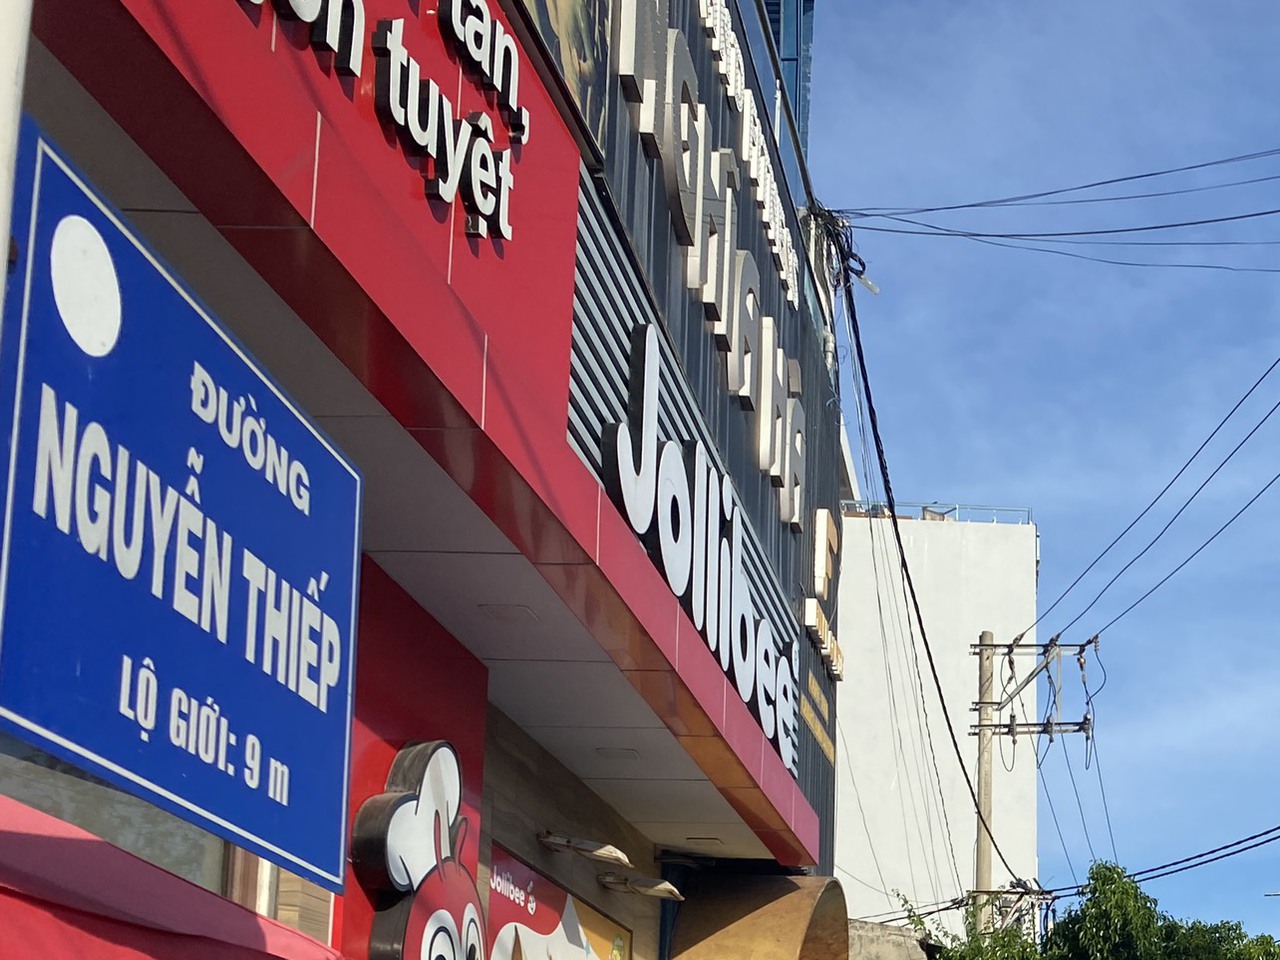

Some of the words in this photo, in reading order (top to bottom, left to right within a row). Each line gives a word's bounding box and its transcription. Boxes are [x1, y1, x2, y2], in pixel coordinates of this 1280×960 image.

[387, 18, 514, 240] tuyệt
[191, 361, 310, 516] ĐƯỜNG
[32, 382, 233, 645] NGUYỄN
[243, 548, 341, 714] THIẾP
[617, 324, 795, 769] Jollibee
[119, 654, 158, 743] LỘ
[243, 733, 261, 790] 9
[267, 756, 290, 807] m
[490, 865, 525, 907] Jollibee
